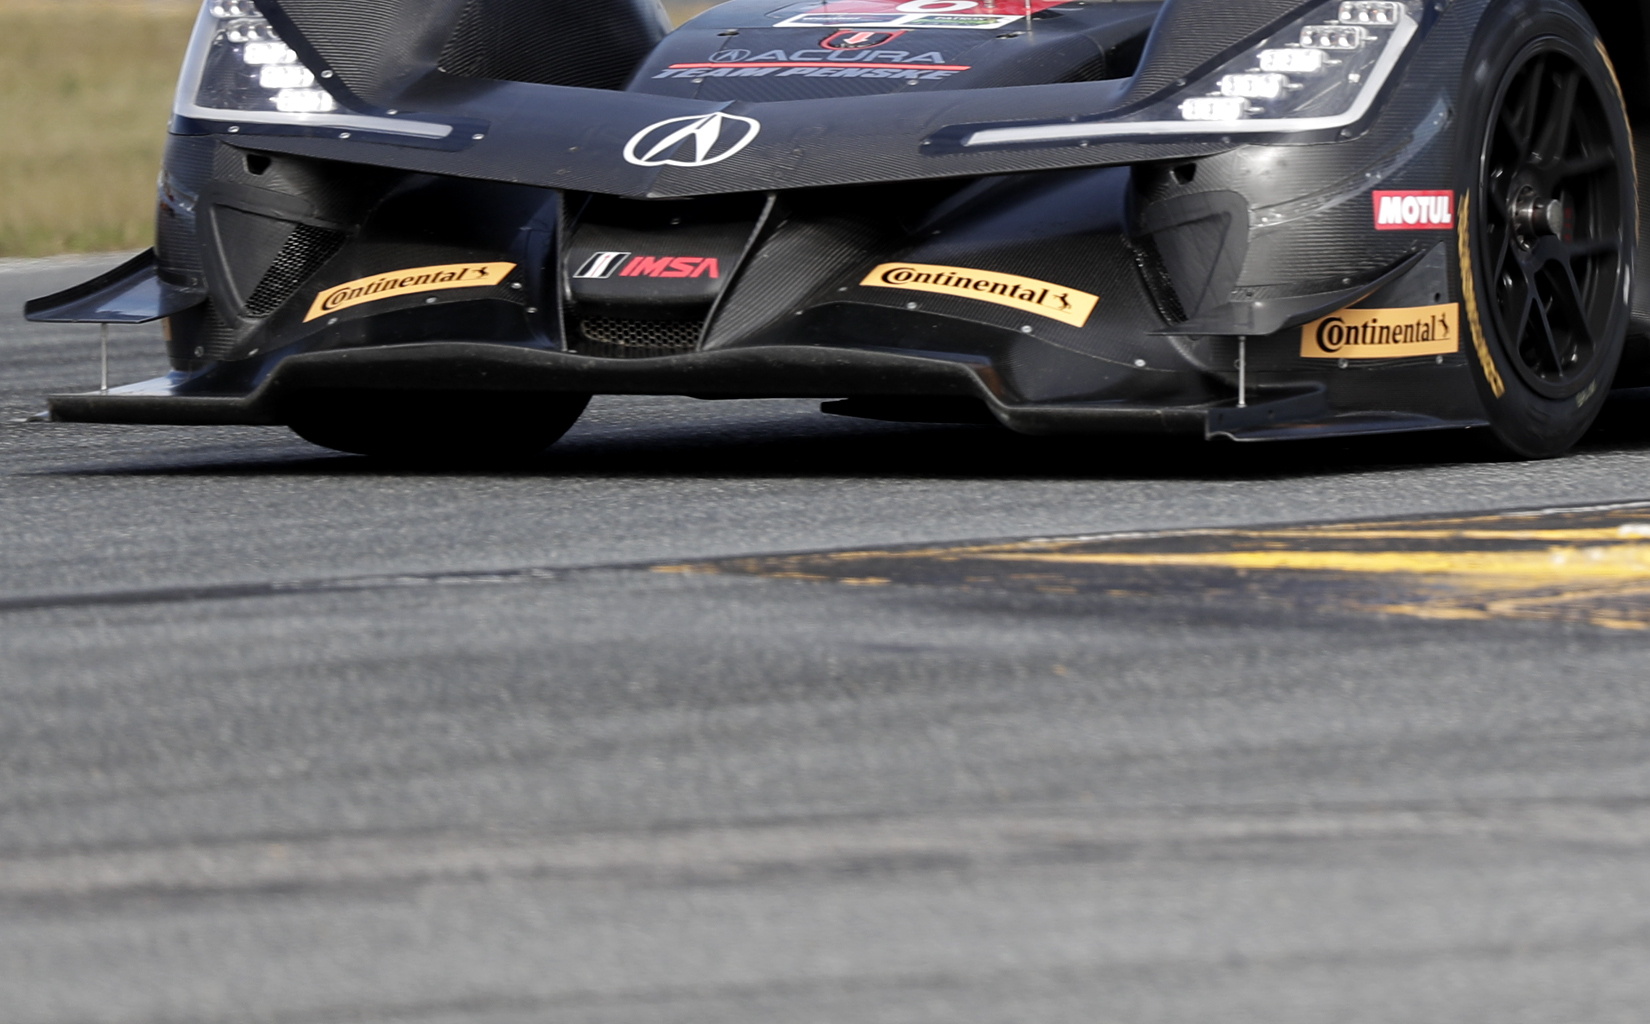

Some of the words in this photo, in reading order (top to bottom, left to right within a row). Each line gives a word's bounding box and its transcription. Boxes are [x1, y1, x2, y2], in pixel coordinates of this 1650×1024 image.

[745, 49, 945, 64] ACURA
[651, 67, 781, 79] TEAM
[777, 67, 960, 80] PENSKE
[1378, 196, 1452, 225] MOTUL
[618, 256, 719, 279] IMSA
[321, 267, 469, 311] Continental
[881, 267, 1050, 305] Continental
[1316, 314, 1436, 353] Continental
